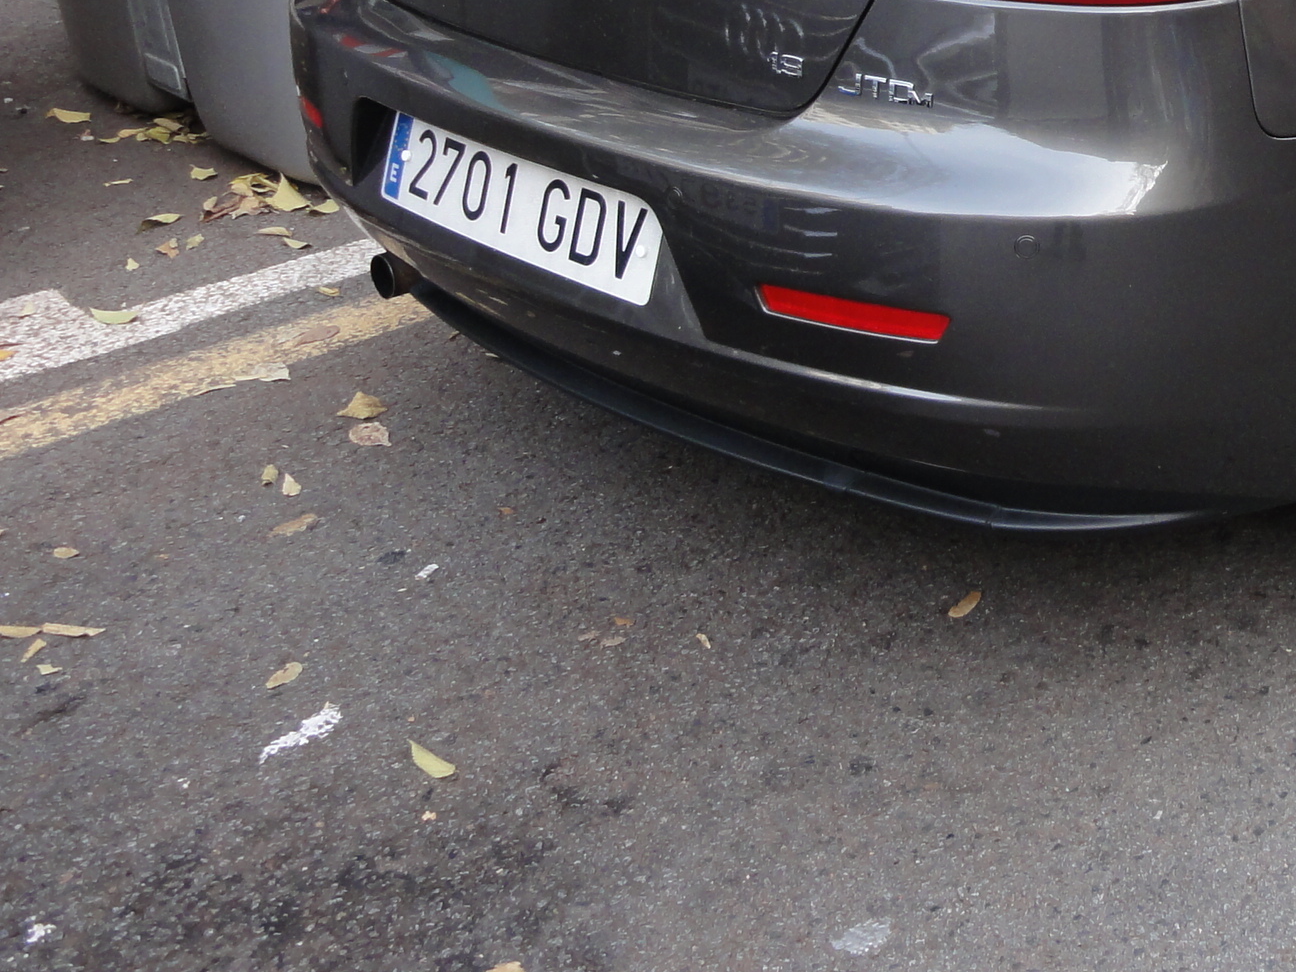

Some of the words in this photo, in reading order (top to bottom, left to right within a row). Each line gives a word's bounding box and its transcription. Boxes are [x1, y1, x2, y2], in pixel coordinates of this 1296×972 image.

[390, 163, 399, 183] E
[409, 129, 518, 235] 2701
[537, 179, 648, 280] GDV
